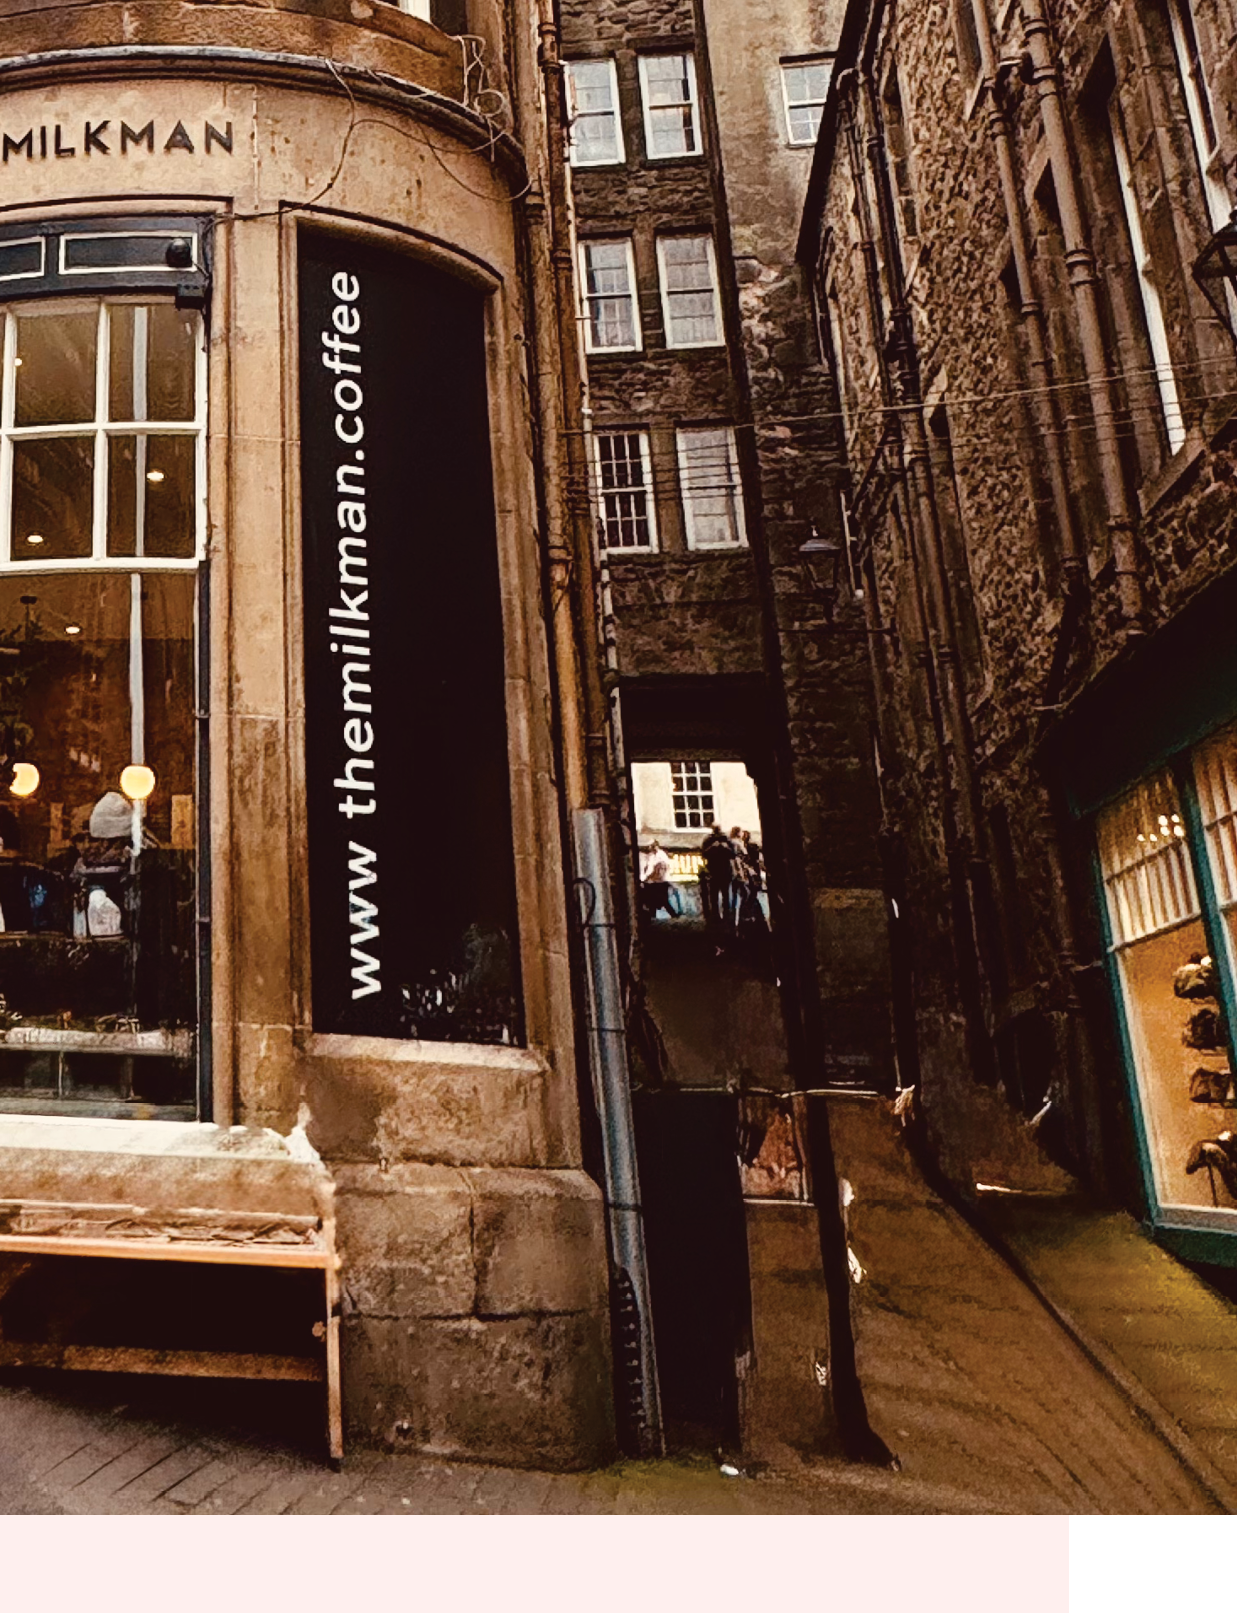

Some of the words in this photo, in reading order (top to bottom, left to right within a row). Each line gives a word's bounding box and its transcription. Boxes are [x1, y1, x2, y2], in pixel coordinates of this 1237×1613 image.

[2, 119, 234, 164] MILKMAN
[321, 270, 378, 819] themilkman.coffee
[347, 839, 382, 1000] www
